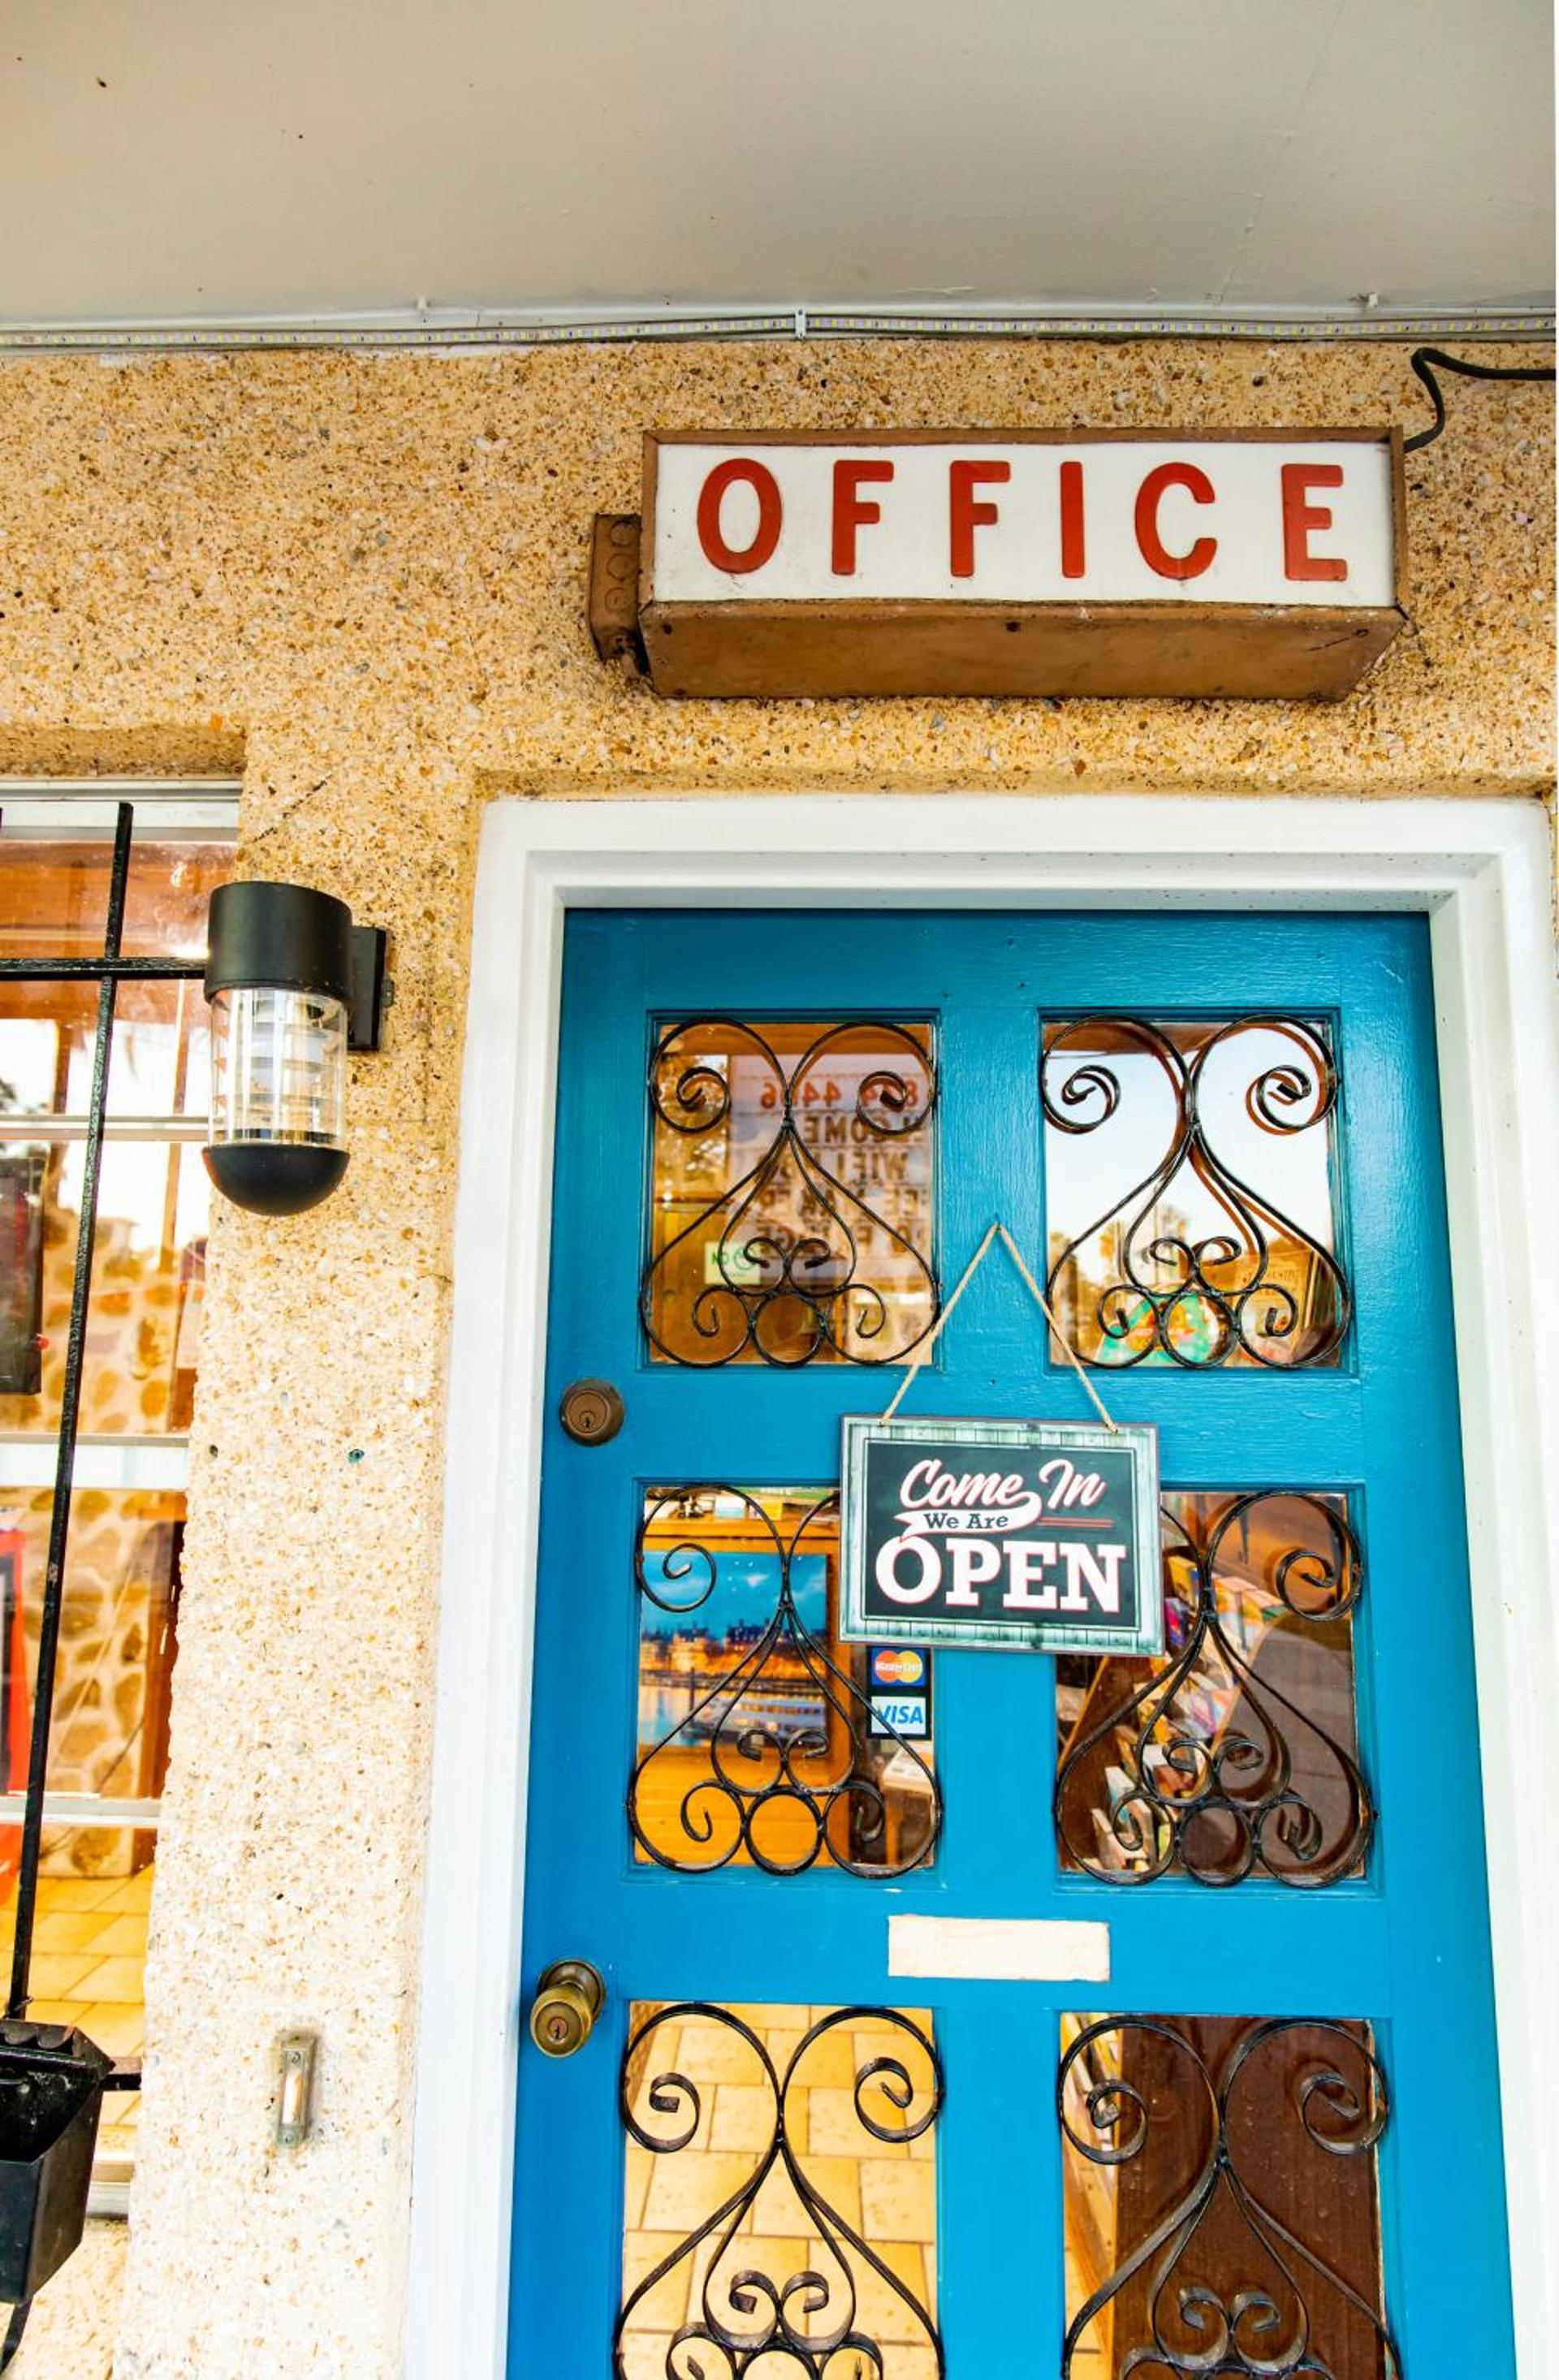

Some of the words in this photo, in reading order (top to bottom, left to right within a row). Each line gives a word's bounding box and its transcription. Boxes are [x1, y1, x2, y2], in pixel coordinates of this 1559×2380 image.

[697, 457, 1348, 582] OFFICE
[900, 1458, 1025, 1508] Come
[1039, 1458, 1107, 1510] In
[923, 1511, 959, 1529] We
[967, 1511, 1009, 1528] Are
[875, 1536, 1126, 1613] OPEN
[877, 1705, 924, 1724] VISA
